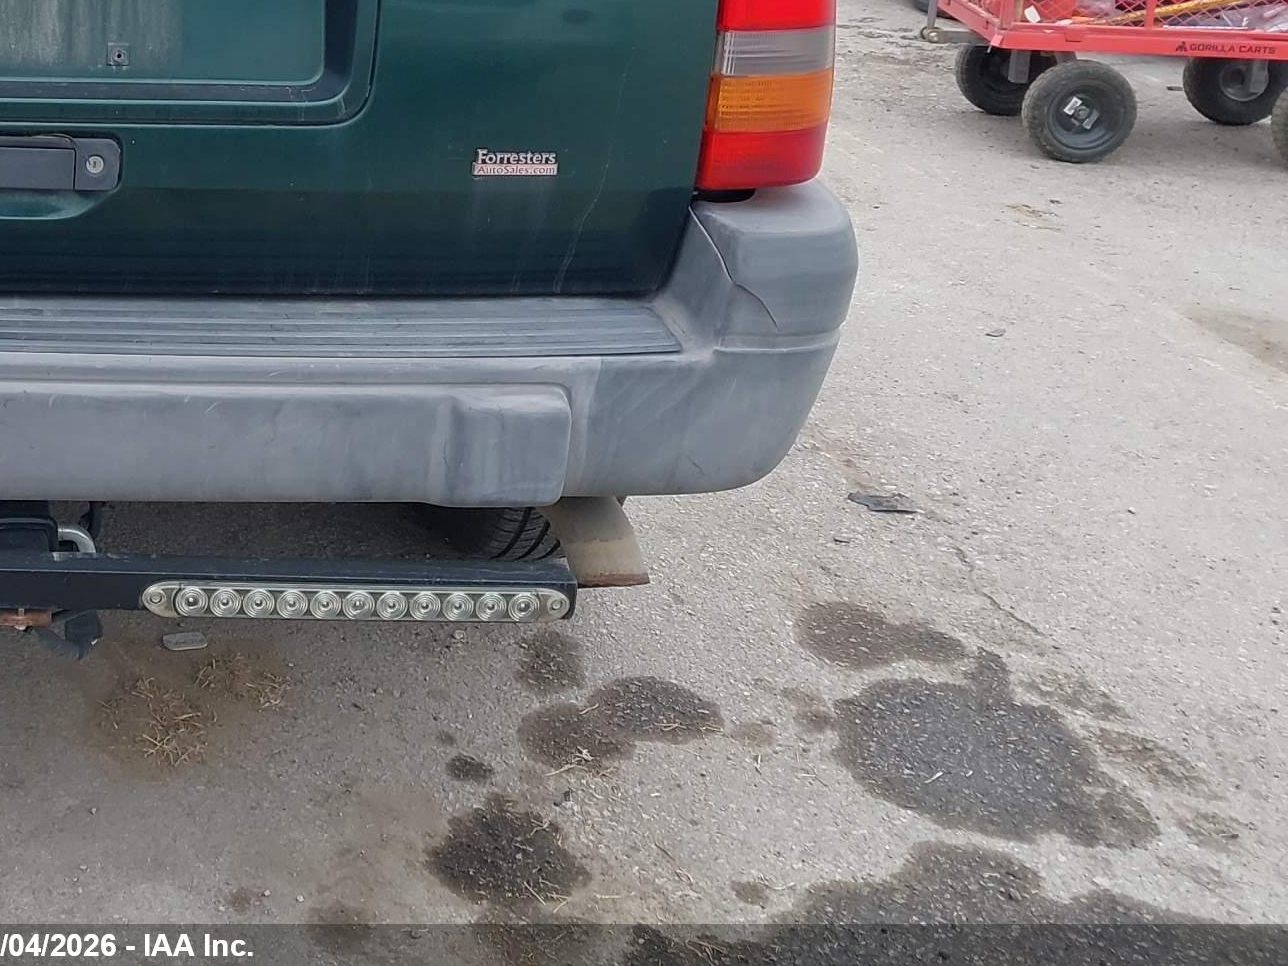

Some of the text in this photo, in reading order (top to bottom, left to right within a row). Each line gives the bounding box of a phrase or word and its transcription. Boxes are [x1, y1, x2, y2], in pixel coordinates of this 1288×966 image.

[1190, 43, 1277, 54] GORILLA CARTS
[476, 148, 557, 164] Forresters
[476, 165, 556, 175] AutoSales.com
